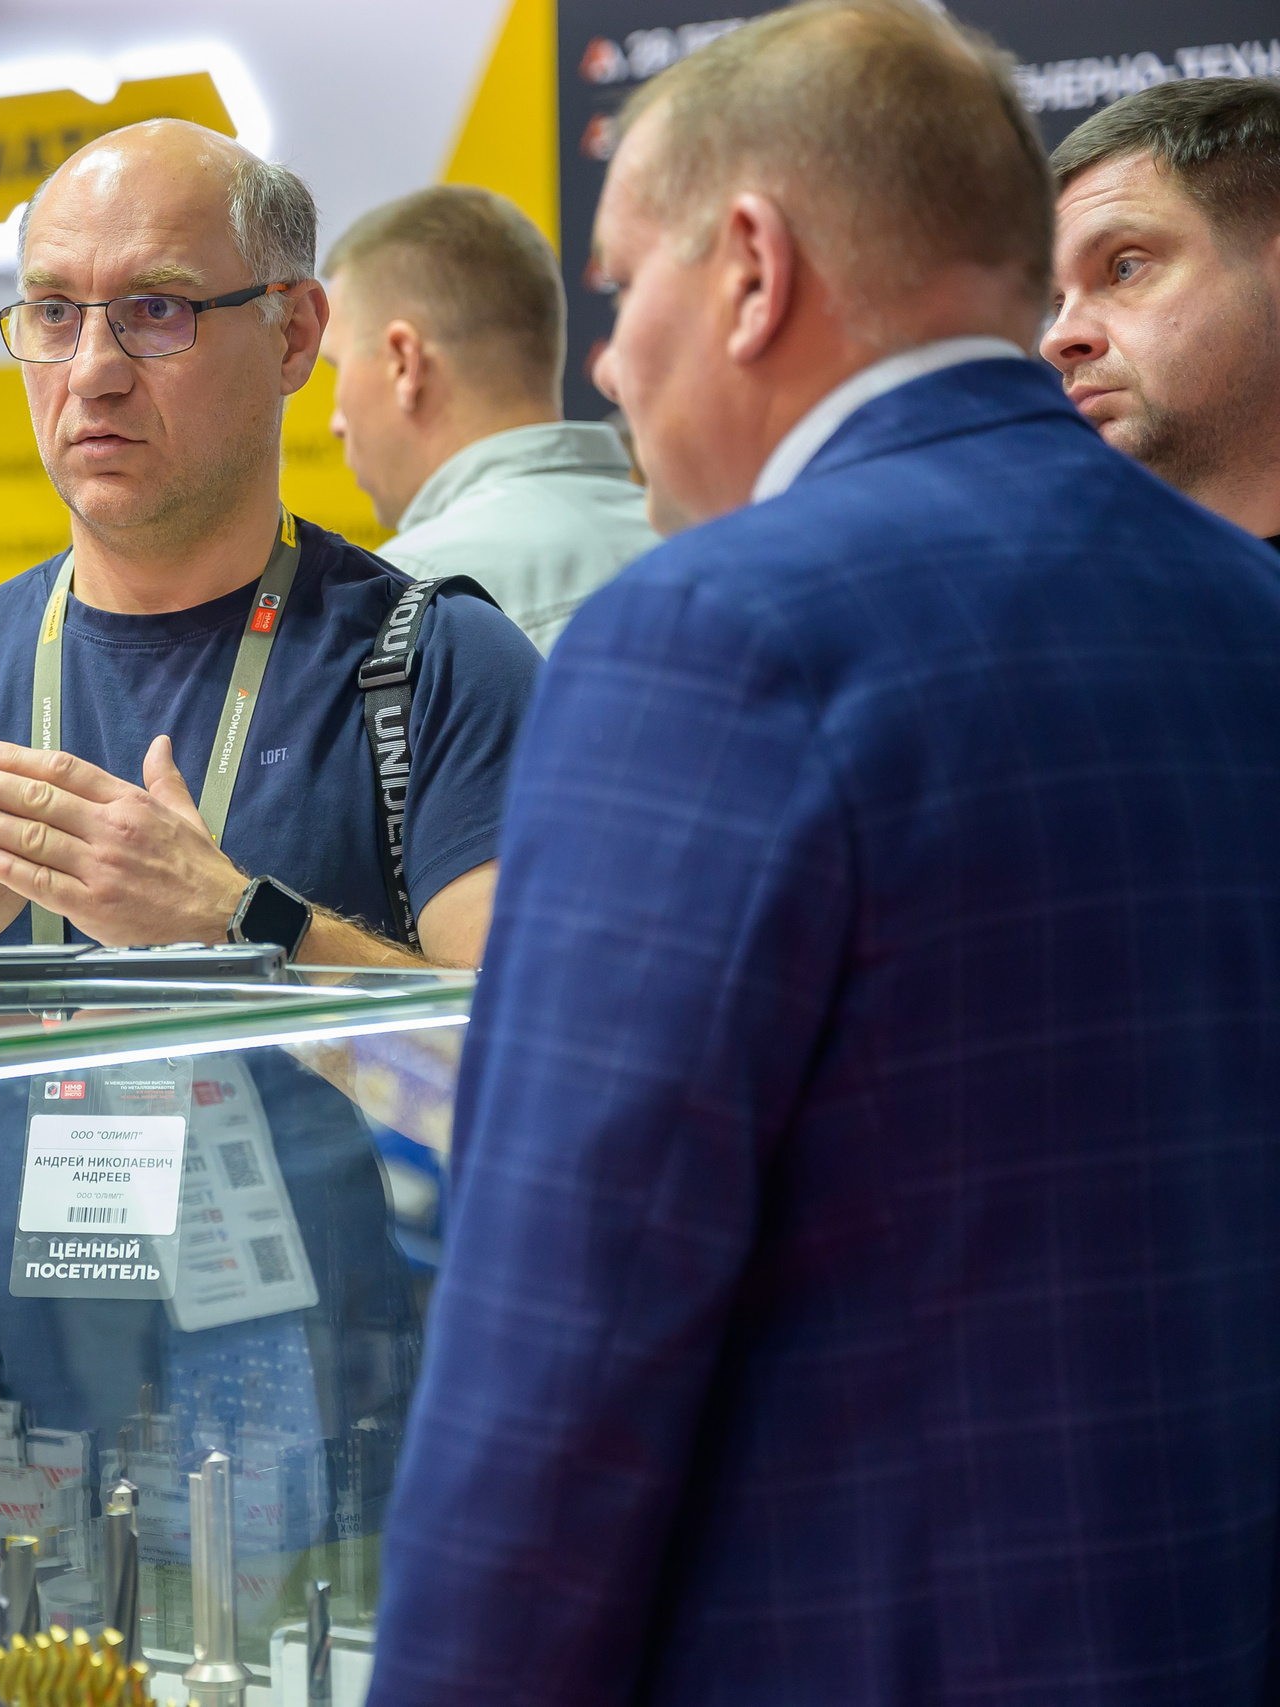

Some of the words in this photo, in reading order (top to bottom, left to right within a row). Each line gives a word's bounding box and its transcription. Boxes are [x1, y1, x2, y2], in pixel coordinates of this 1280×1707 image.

[42, 696, 52, 751] МАРСЕНАЛ
[217, 701, 245, 774] ПРОМАРСЕНАЛ
[70, 1130, 94, 1140] ООО
[97, 1131, 143, 1140] "ОЛИМП"
[34, 1155, 84, 1168] АНДРЕЙ
[87, 1157, 173, 1169] НИКОЛАЕВИЧ
[72, 1171, 131, 1184] АНДРЕЕВ
[48, 1239, 140, 1261] ЦЕННЫЙ
[25, 1262, 161, 1282] ПОСЕТИТЕЛЬ
